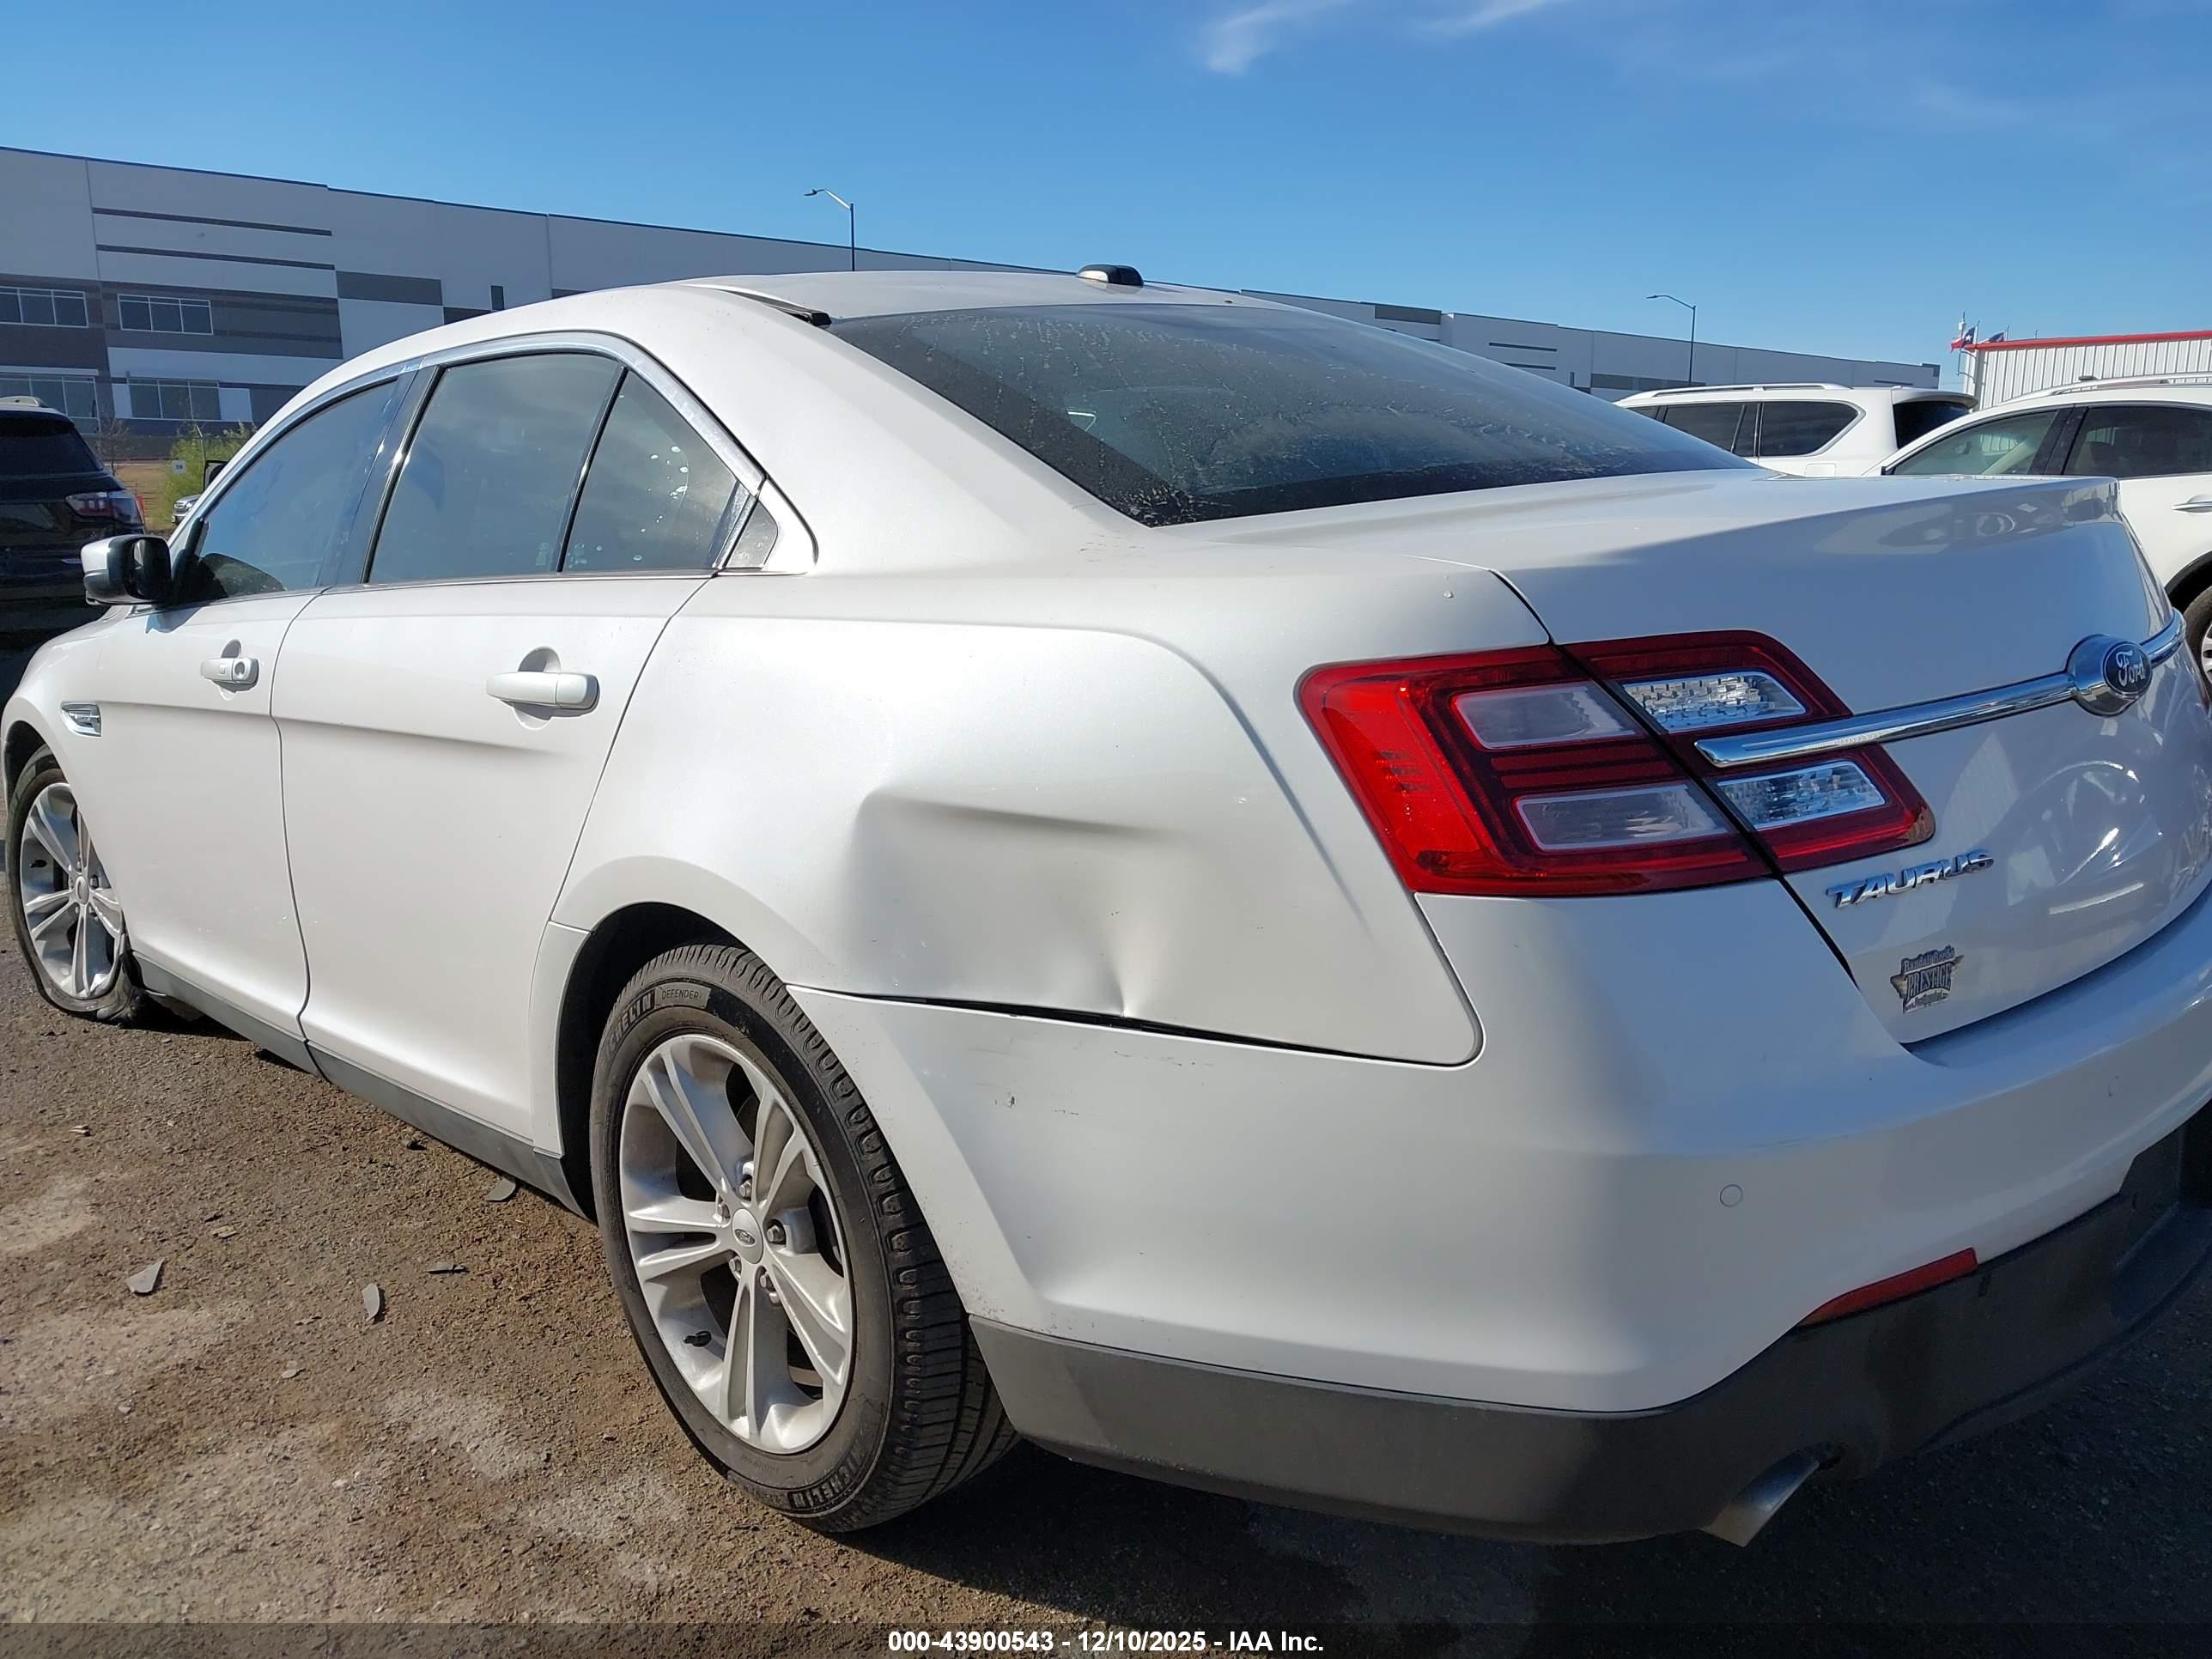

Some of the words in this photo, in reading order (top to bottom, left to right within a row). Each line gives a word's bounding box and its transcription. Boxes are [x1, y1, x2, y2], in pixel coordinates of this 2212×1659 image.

[2115, 649, 2146, 687] Ford
[1826, 848, 1994, 908] TAURUS
[661, 988, 699, 1000] DEFENDER
[1906, 962, 1952, 1002] PRESTIGE
